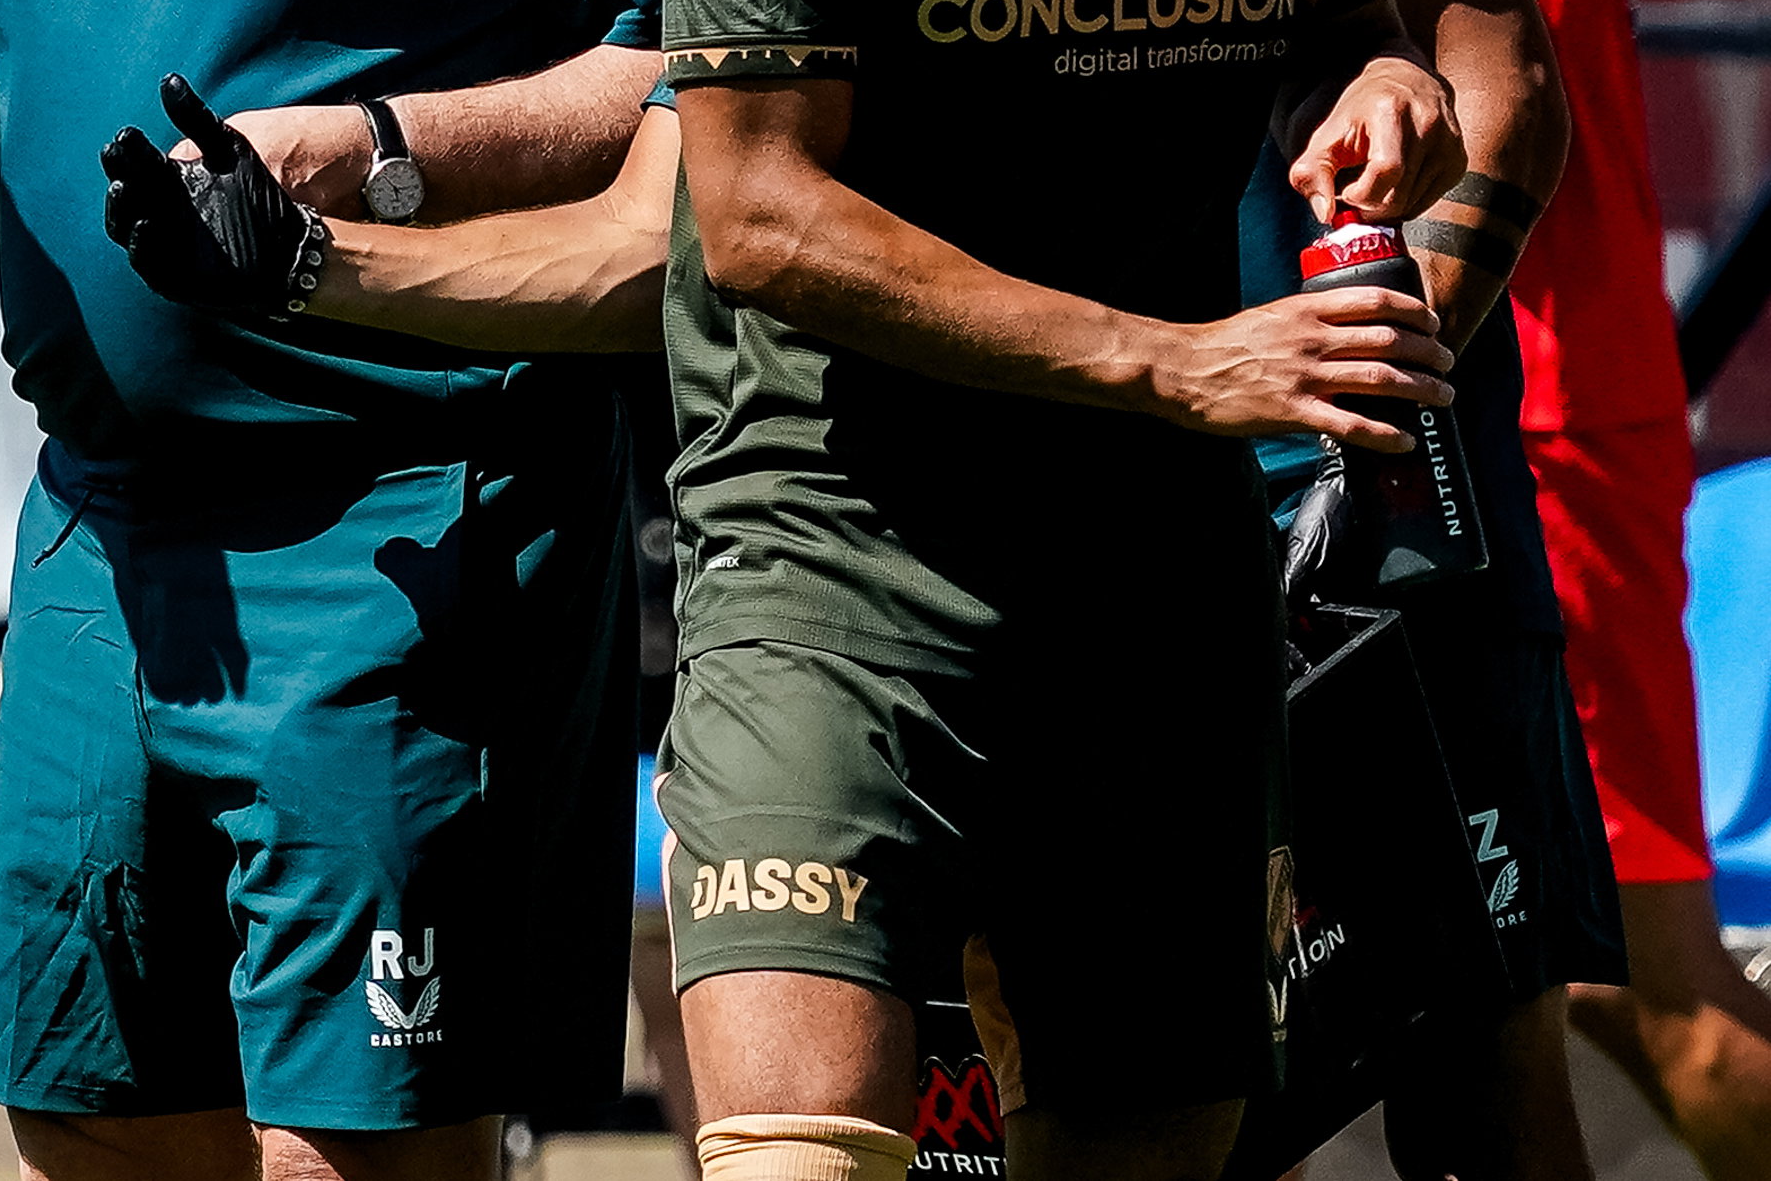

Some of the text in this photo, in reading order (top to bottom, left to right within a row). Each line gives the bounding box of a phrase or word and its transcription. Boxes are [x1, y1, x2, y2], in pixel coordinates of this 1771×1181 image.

[1054, 46, 1139, 77] digital
[1419, 404, 1464, 536] NUTRITIO
[691, 857, 869, 922] DASSY
[371, 927, 435, 980] RJ
[370, 1029, 443, 1047] CASTORE
[908, 1150, 1007, 1177] UTRIT
